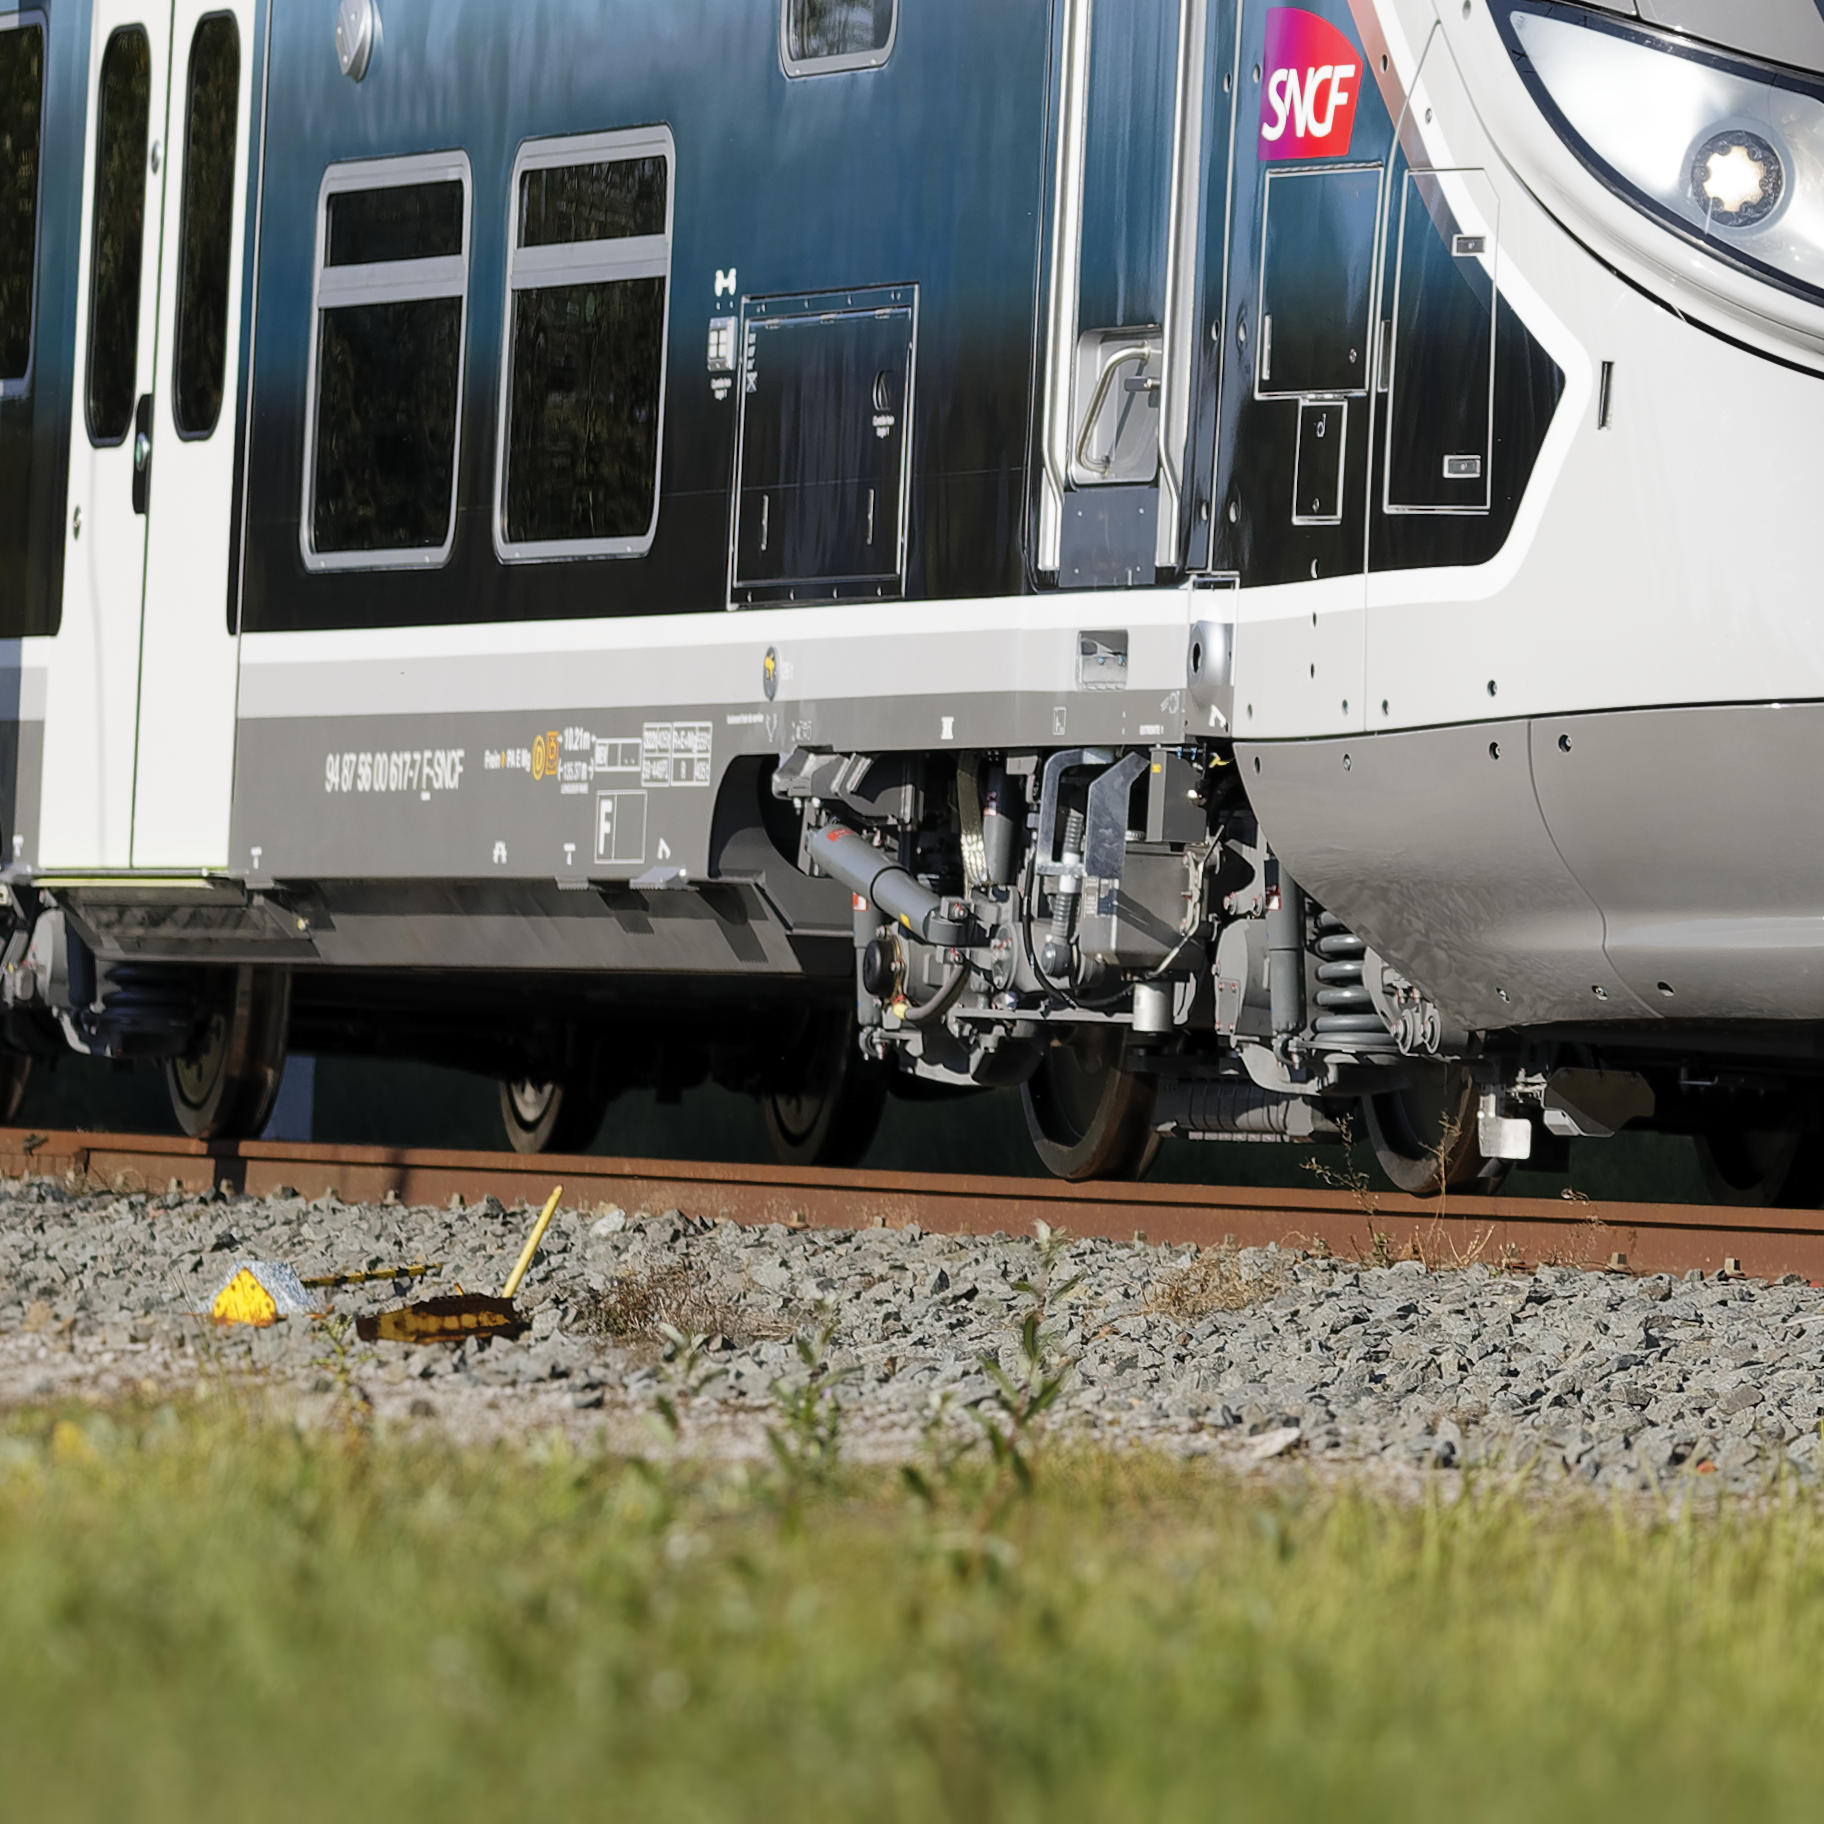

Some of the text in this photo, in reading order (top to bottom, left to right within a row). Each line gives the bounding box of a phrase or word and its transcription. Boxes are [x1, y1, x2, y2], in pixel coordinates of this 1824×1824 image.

[1261, 64, 1355, 141] SNCF
[325, 752, 340, 792] 94
[341, 752, 357, 792] 87
[599, 799, 613, 855] F
